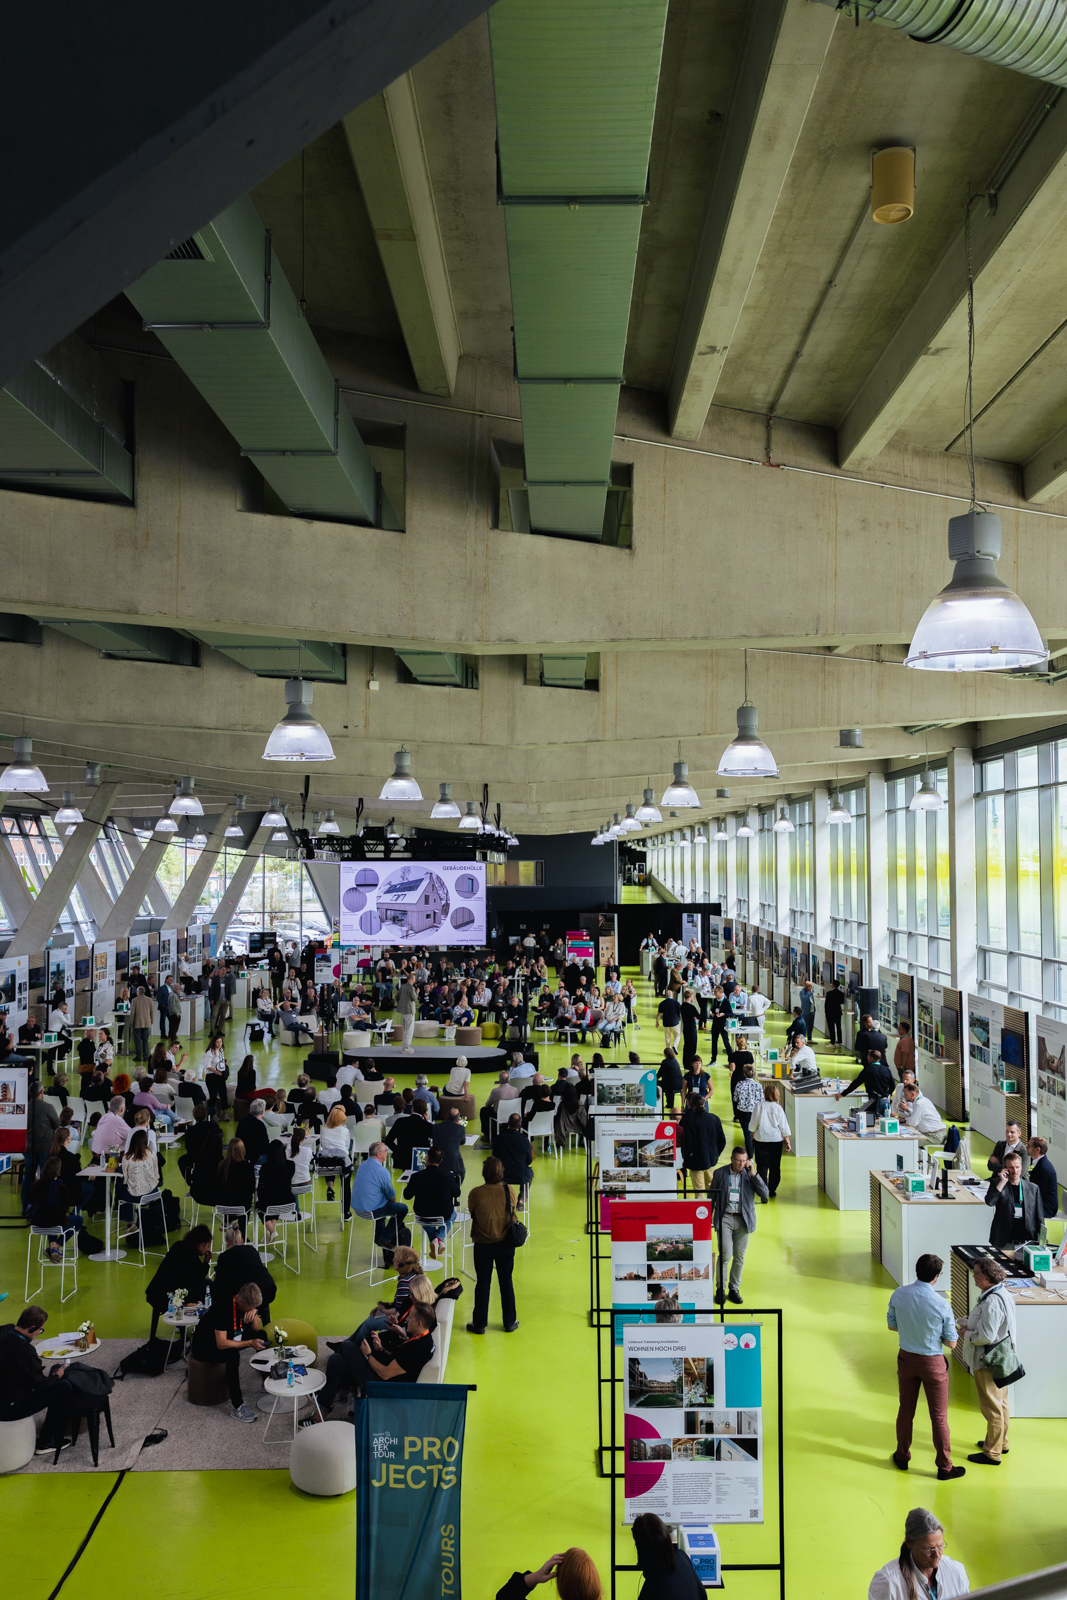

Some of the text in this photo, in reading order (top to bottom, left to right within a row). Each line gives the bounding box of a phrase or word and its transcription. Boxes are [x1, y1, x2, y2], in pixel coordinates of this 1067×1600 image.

[373, 1437, 398, 1445] ARCHI
[404, 1436, 459, 1462] PRO
[373, 1451, 395, 1459] TOUR
[372, 1463, 457, 1489] JECTS
[440, 1523, 455, 1597] TOURS
